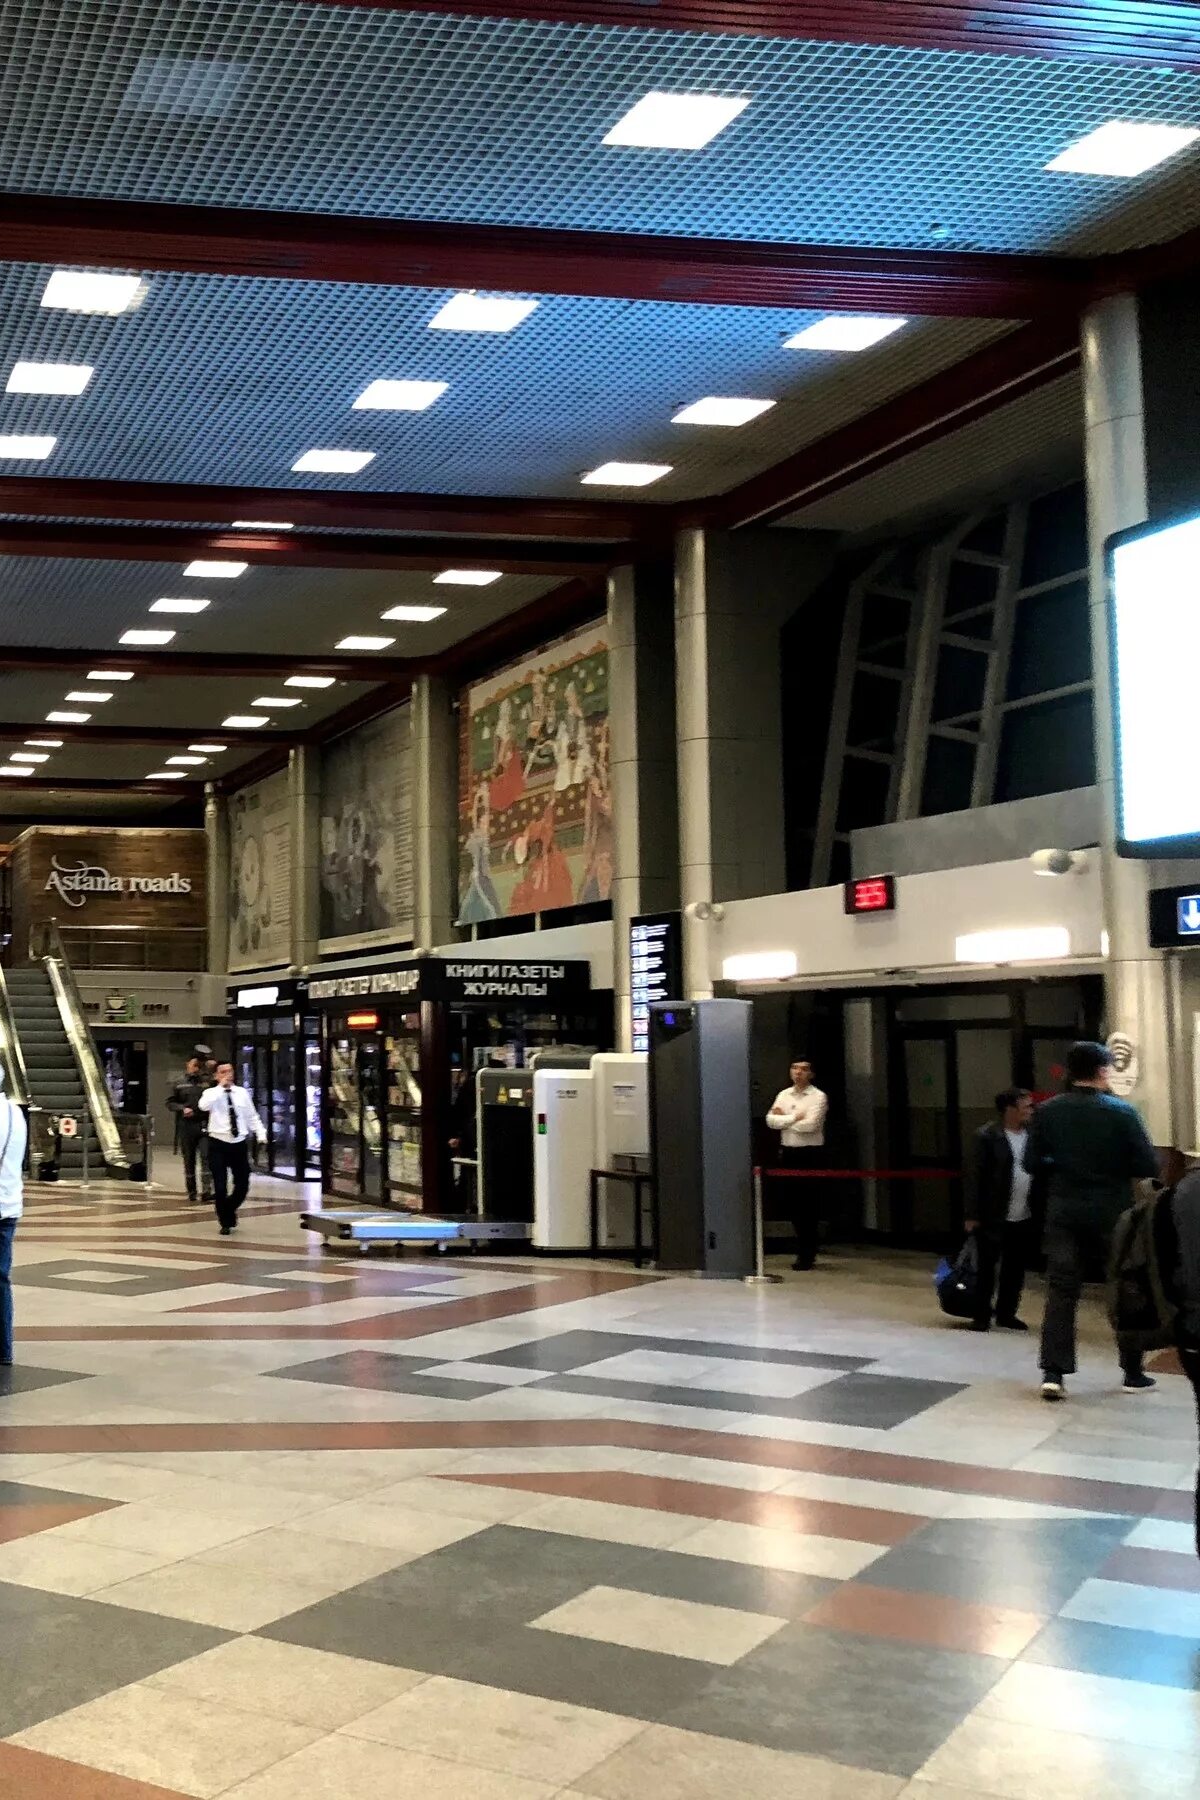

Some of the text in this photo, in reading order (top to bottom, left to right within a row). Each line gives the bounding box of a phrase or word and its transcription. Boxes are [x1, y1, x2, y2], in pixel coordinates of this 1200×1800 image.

[44, 855, 192, 907] Astana roads
[445, 964, 565, 979] КНИГИ ГАЗЕТЫ
[463, 982, 548, 996] ЖУРНАЛЫ
